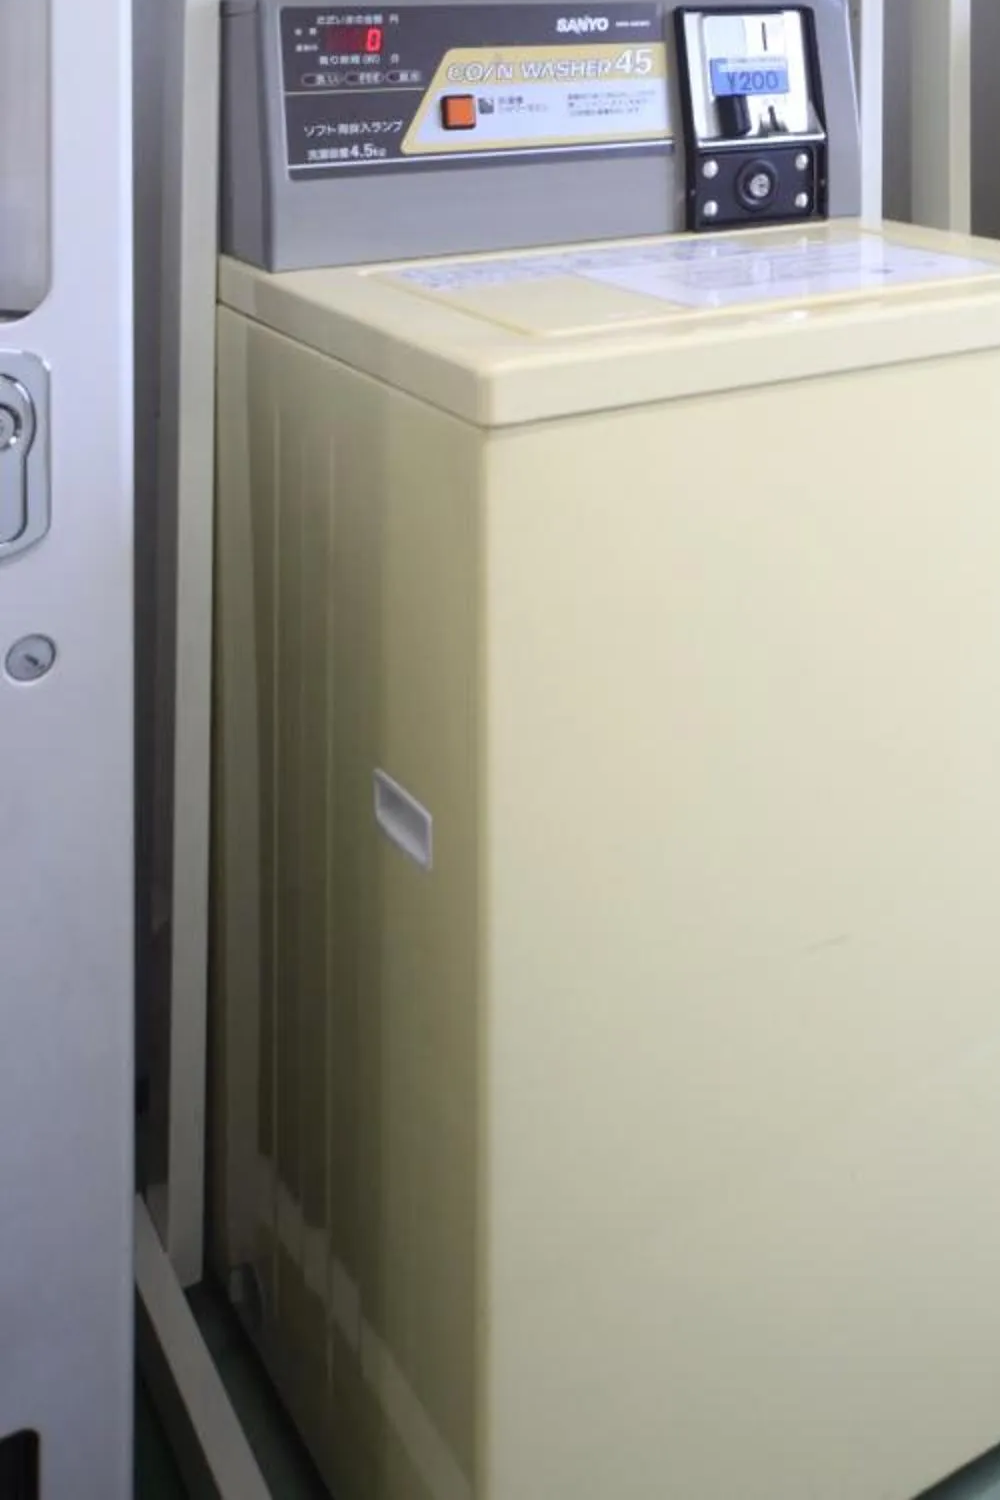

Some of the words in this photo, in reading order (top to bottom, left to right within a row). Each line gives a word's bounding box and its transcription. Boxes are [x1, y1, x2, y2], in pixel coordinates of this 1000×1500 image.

[556, 17, 609, 34] SANYO
[366, 28, 382, 52] 0
[520, 59, 612, 80] WASHER
[615, 49, 653, 75] 45
